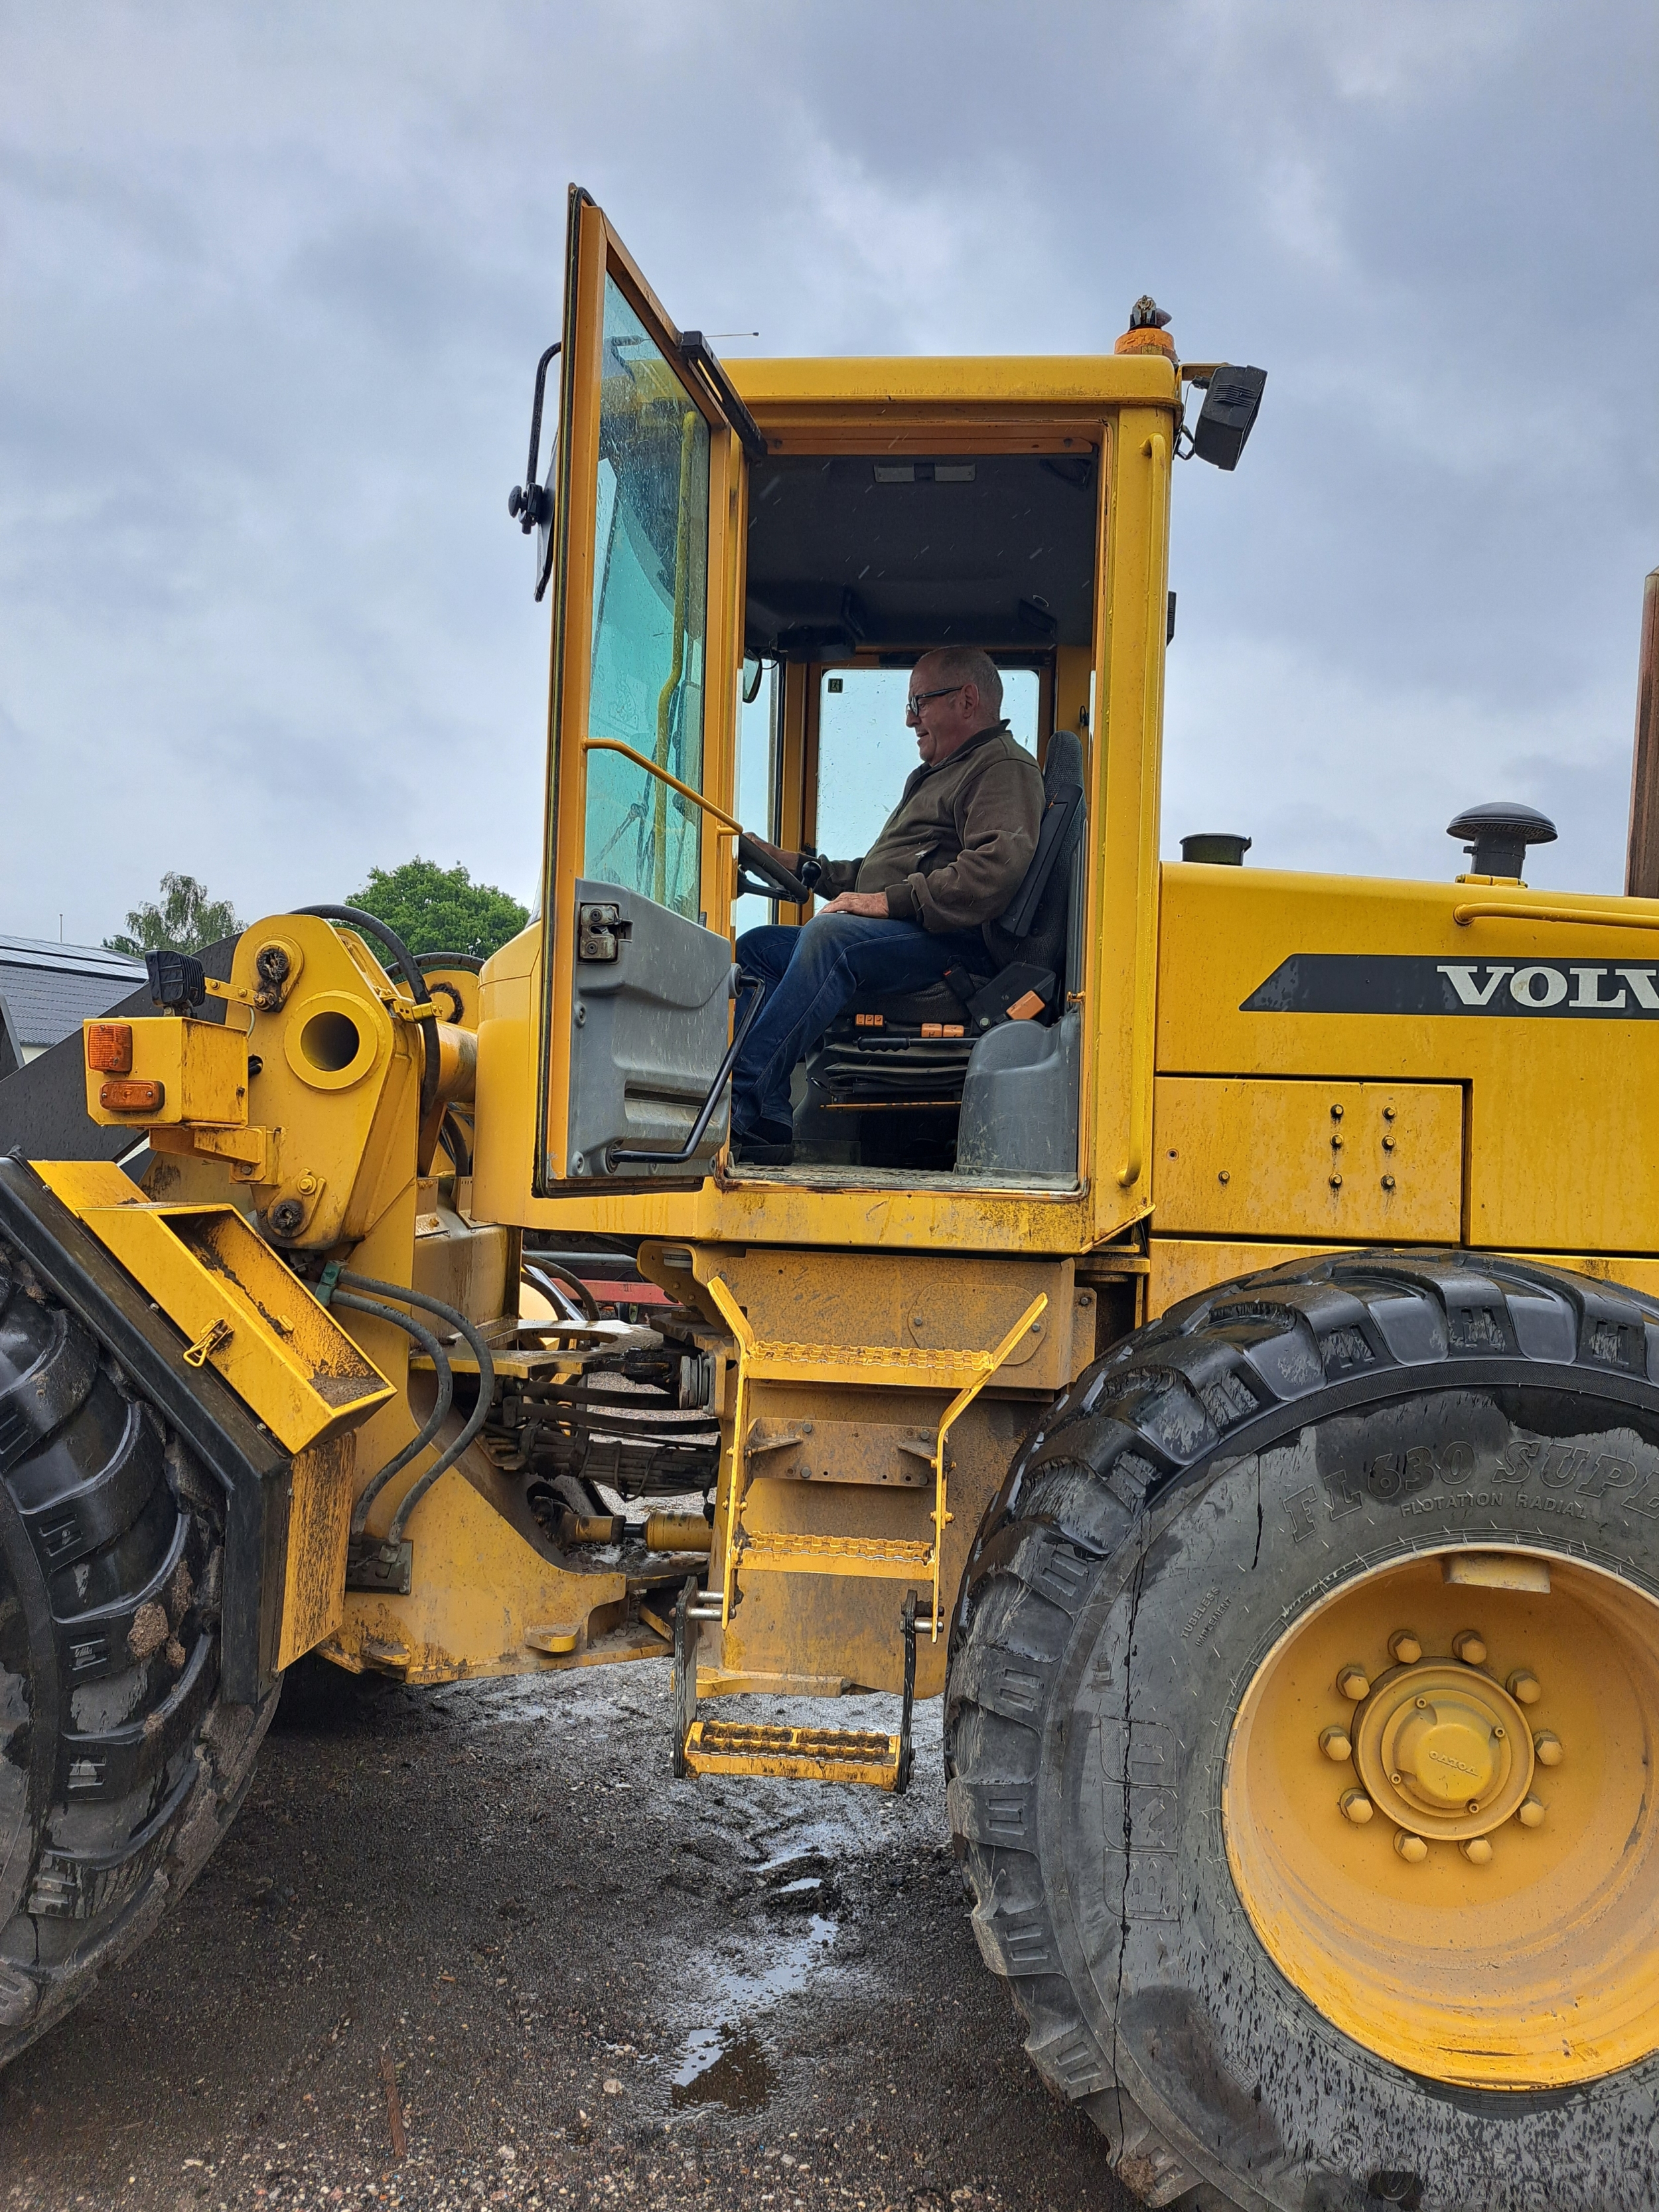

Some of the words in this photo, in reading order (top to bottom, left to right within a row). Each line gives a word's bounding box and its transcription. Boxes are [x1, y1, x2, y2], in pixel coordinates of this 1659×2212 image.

[1401, 1493, 1503, 1517] FLOTATION
[1515, 1493, 1587, 1519] RADIAL
[1180, 1586, 1220, 1639] TUBELESS
[1195, 1596, 1232, 1647] IMPLEMENT
